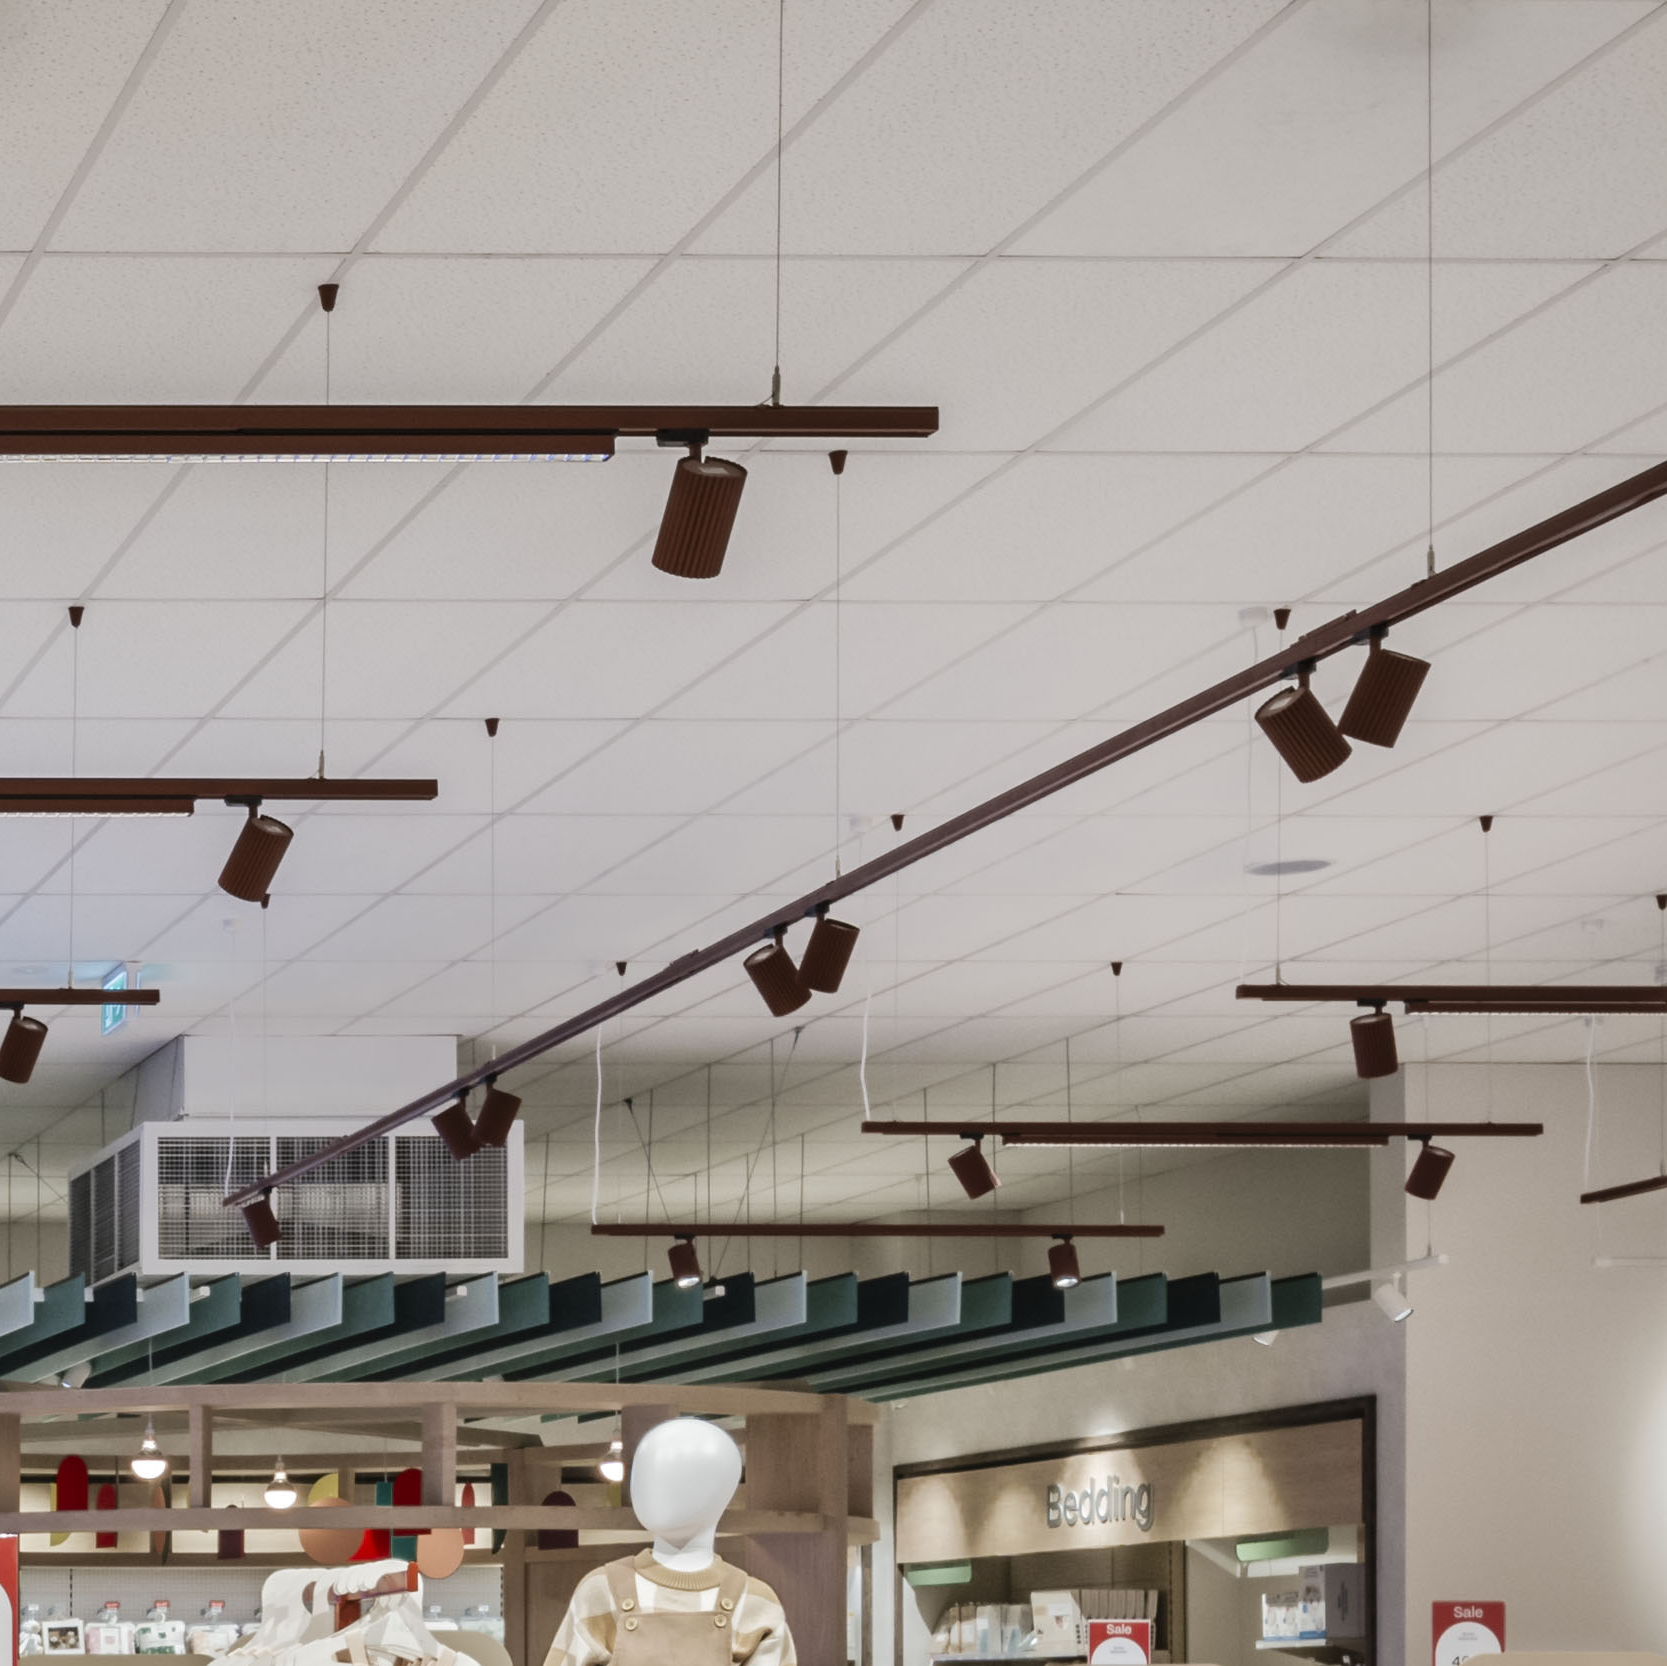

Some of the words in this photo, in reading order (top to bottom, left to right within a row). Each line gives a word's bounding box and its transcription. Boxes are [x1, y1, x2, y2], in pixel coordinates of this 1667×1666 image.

[1047, 1475, 1155, 1532] Bedding
[1453, 1606, 1484, 1619] Sale
[1106, 1623, 1132, 1636] Sale
